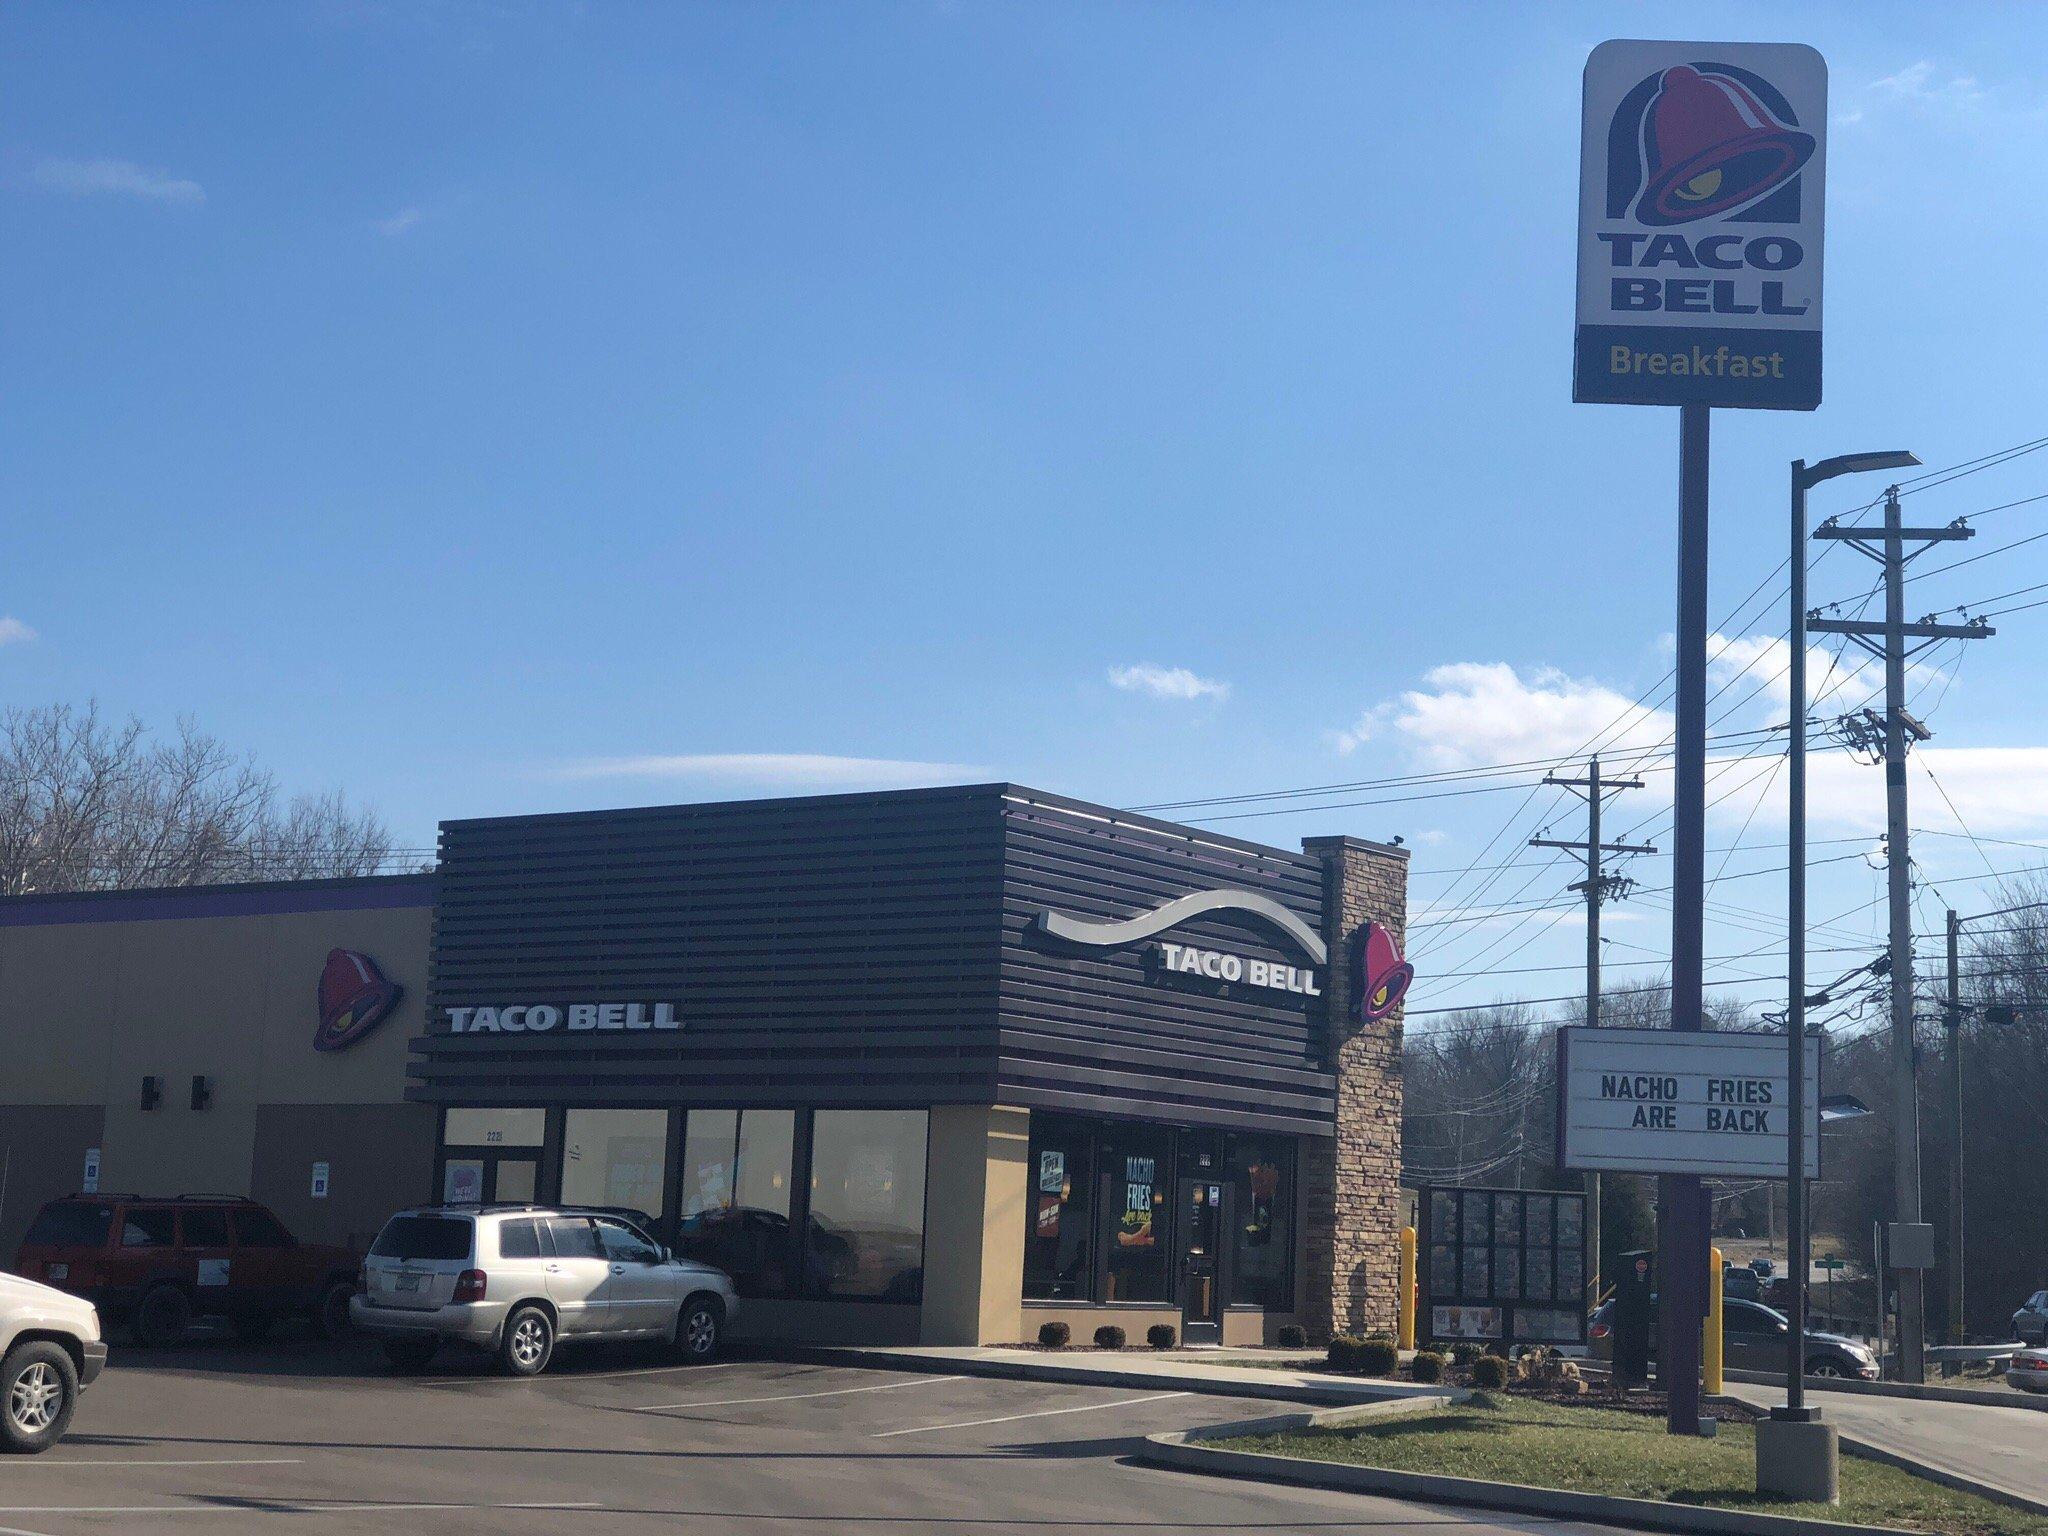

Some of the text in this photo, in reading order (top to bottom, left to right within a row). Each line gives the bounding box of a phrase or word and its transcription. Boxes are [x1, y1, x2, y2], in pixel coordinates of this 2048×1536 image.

[1597, 233, 1804, 271] TACO
[1610, 277, 1809, 316] BELL
[1610, 345, 1786, 379] Breakfast
[1161, 942, 1322, 997] TACO BELL
[445, 1003, 682, 1032] TACO BELL
[1601, 1074, 1773, 1104] NACHO FRIES
[1632, 1105, 1769, 1132] ARE BACK
[1126, 1156, 1155, 1184] NACHO
[1127, 1183, 1151, 1211] FRIES
